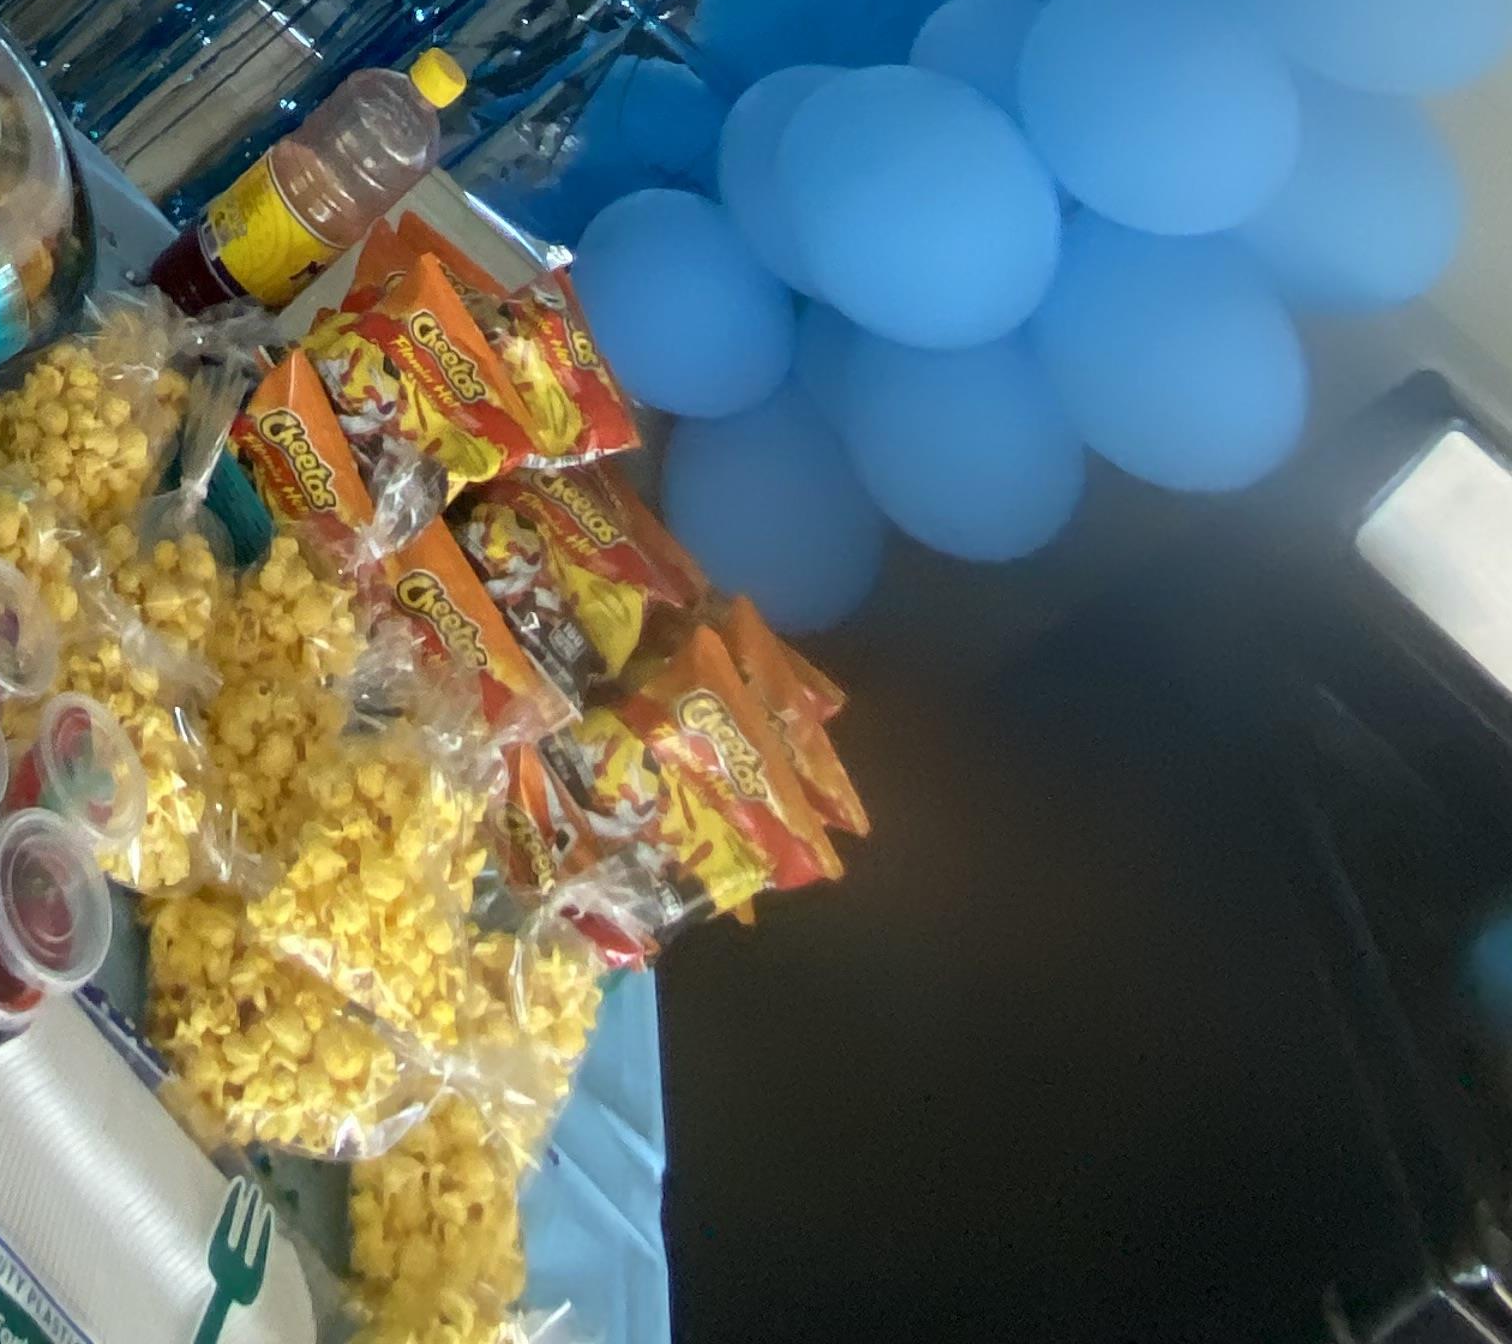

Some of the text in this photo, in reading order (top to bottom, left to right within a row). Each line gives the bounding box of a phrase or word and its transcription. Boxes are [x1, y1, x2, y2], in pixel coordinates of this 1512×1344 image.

[410, 310, 485, 402] Cheetos
[260, 410, 336, 511] Cheetos
[531, 472, 620, 546] Cheetos
[397, 571, 486, 666] Cheetos
[679, 689, 768, 799] Cheetos
